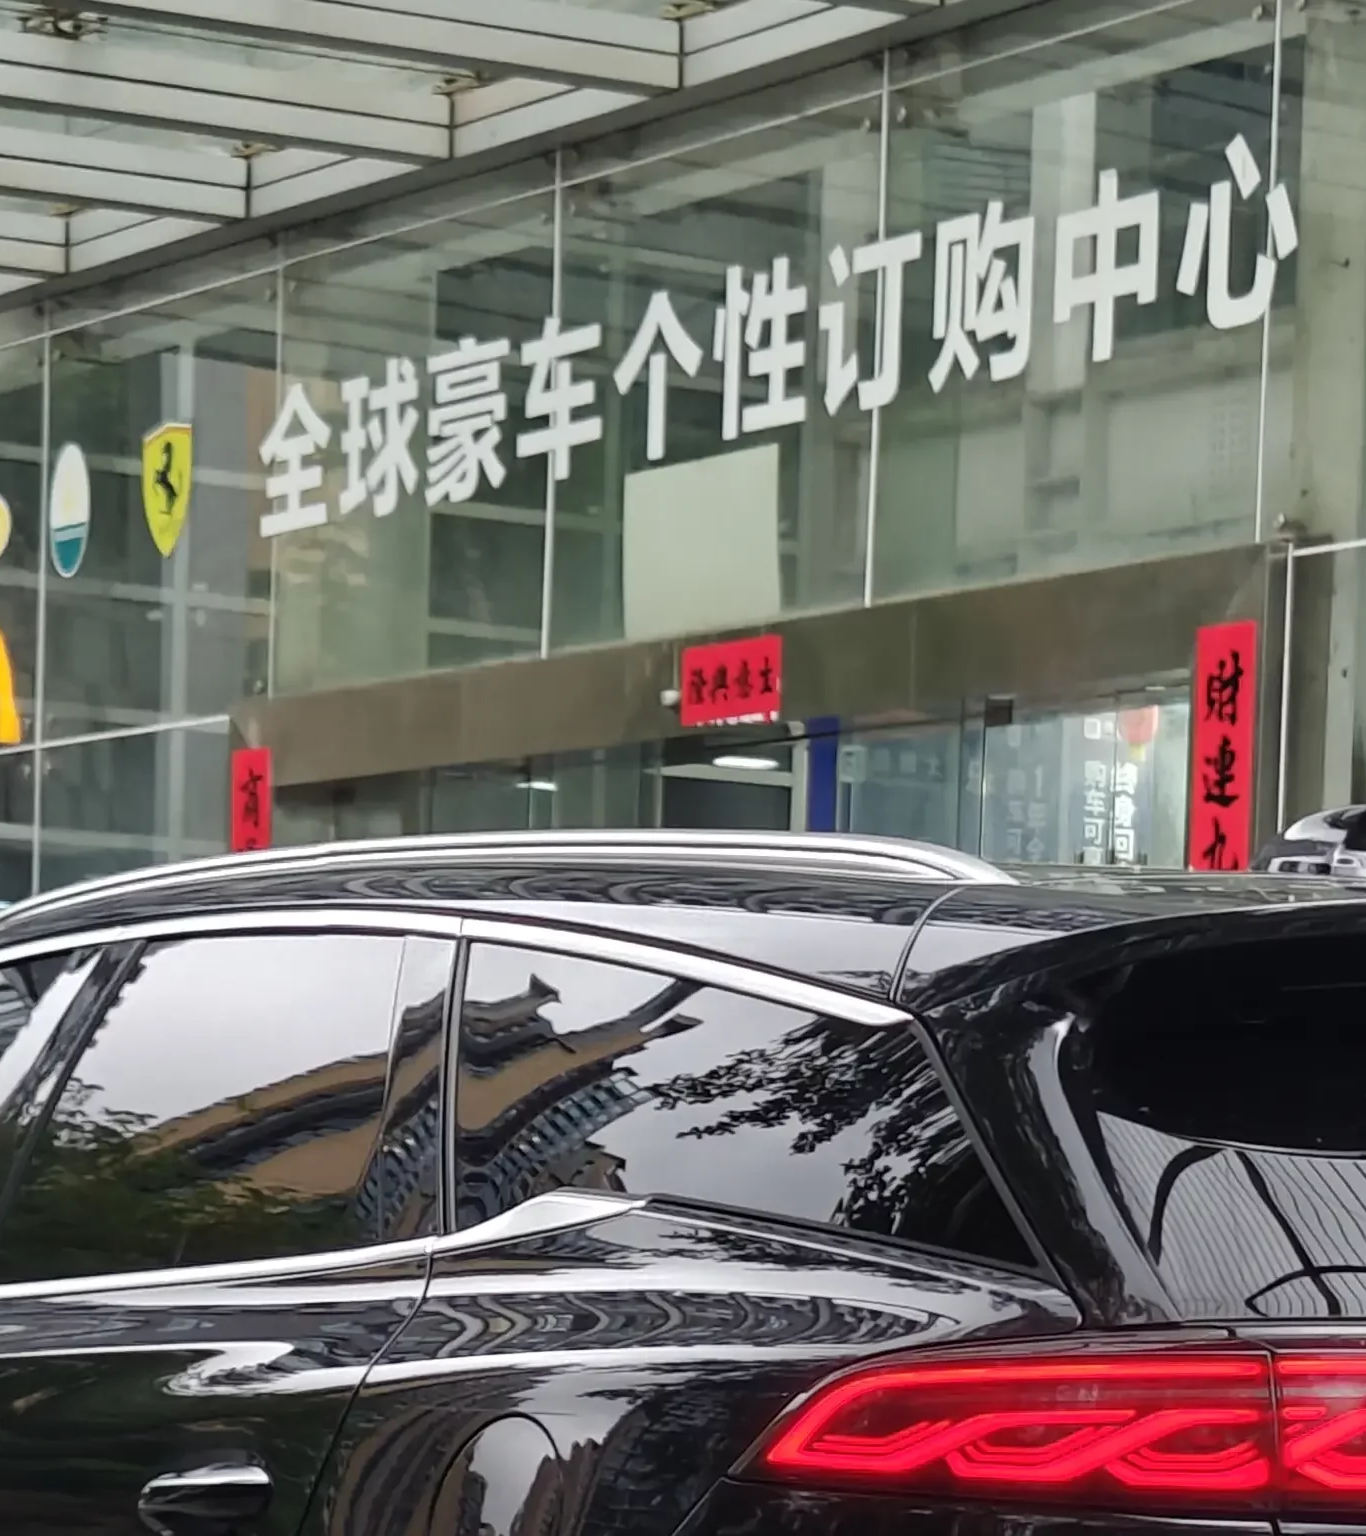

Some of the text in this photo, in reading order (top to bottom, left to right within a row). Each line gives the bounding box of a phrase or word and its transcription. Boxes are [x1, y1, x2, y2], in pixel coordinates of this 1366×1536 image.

[258, 133, 1299, 538] 全球豪车个性订购中心
